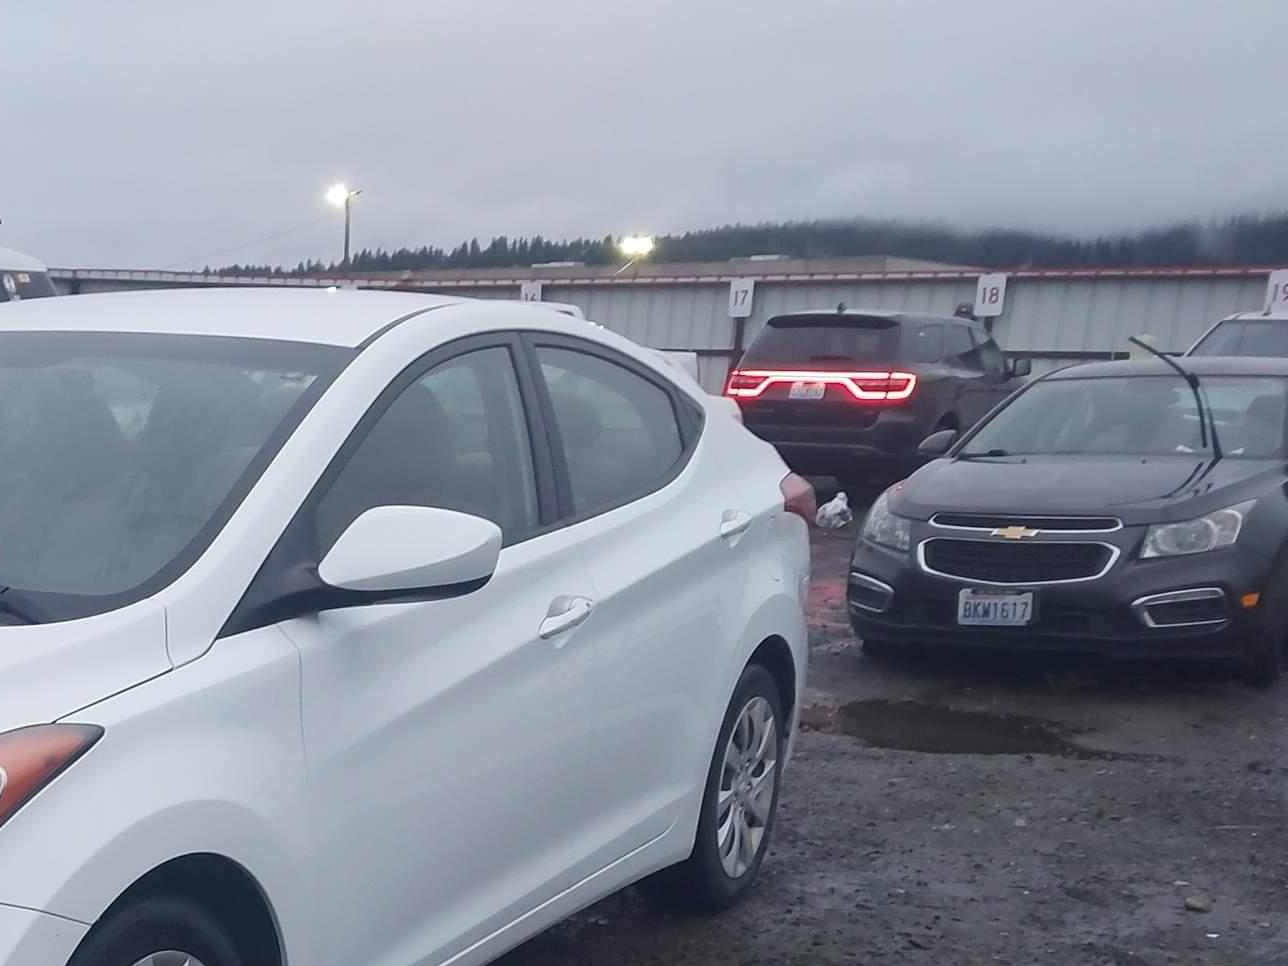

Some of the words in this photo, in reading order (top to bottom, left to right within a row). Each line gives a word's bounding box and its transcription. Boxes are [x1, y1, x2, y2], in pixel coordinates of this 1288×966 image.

[734, 289, 748, 305] 17
[982, 286, 1000, 304] 18
[962, 600, 1029, 619] BKW1617
